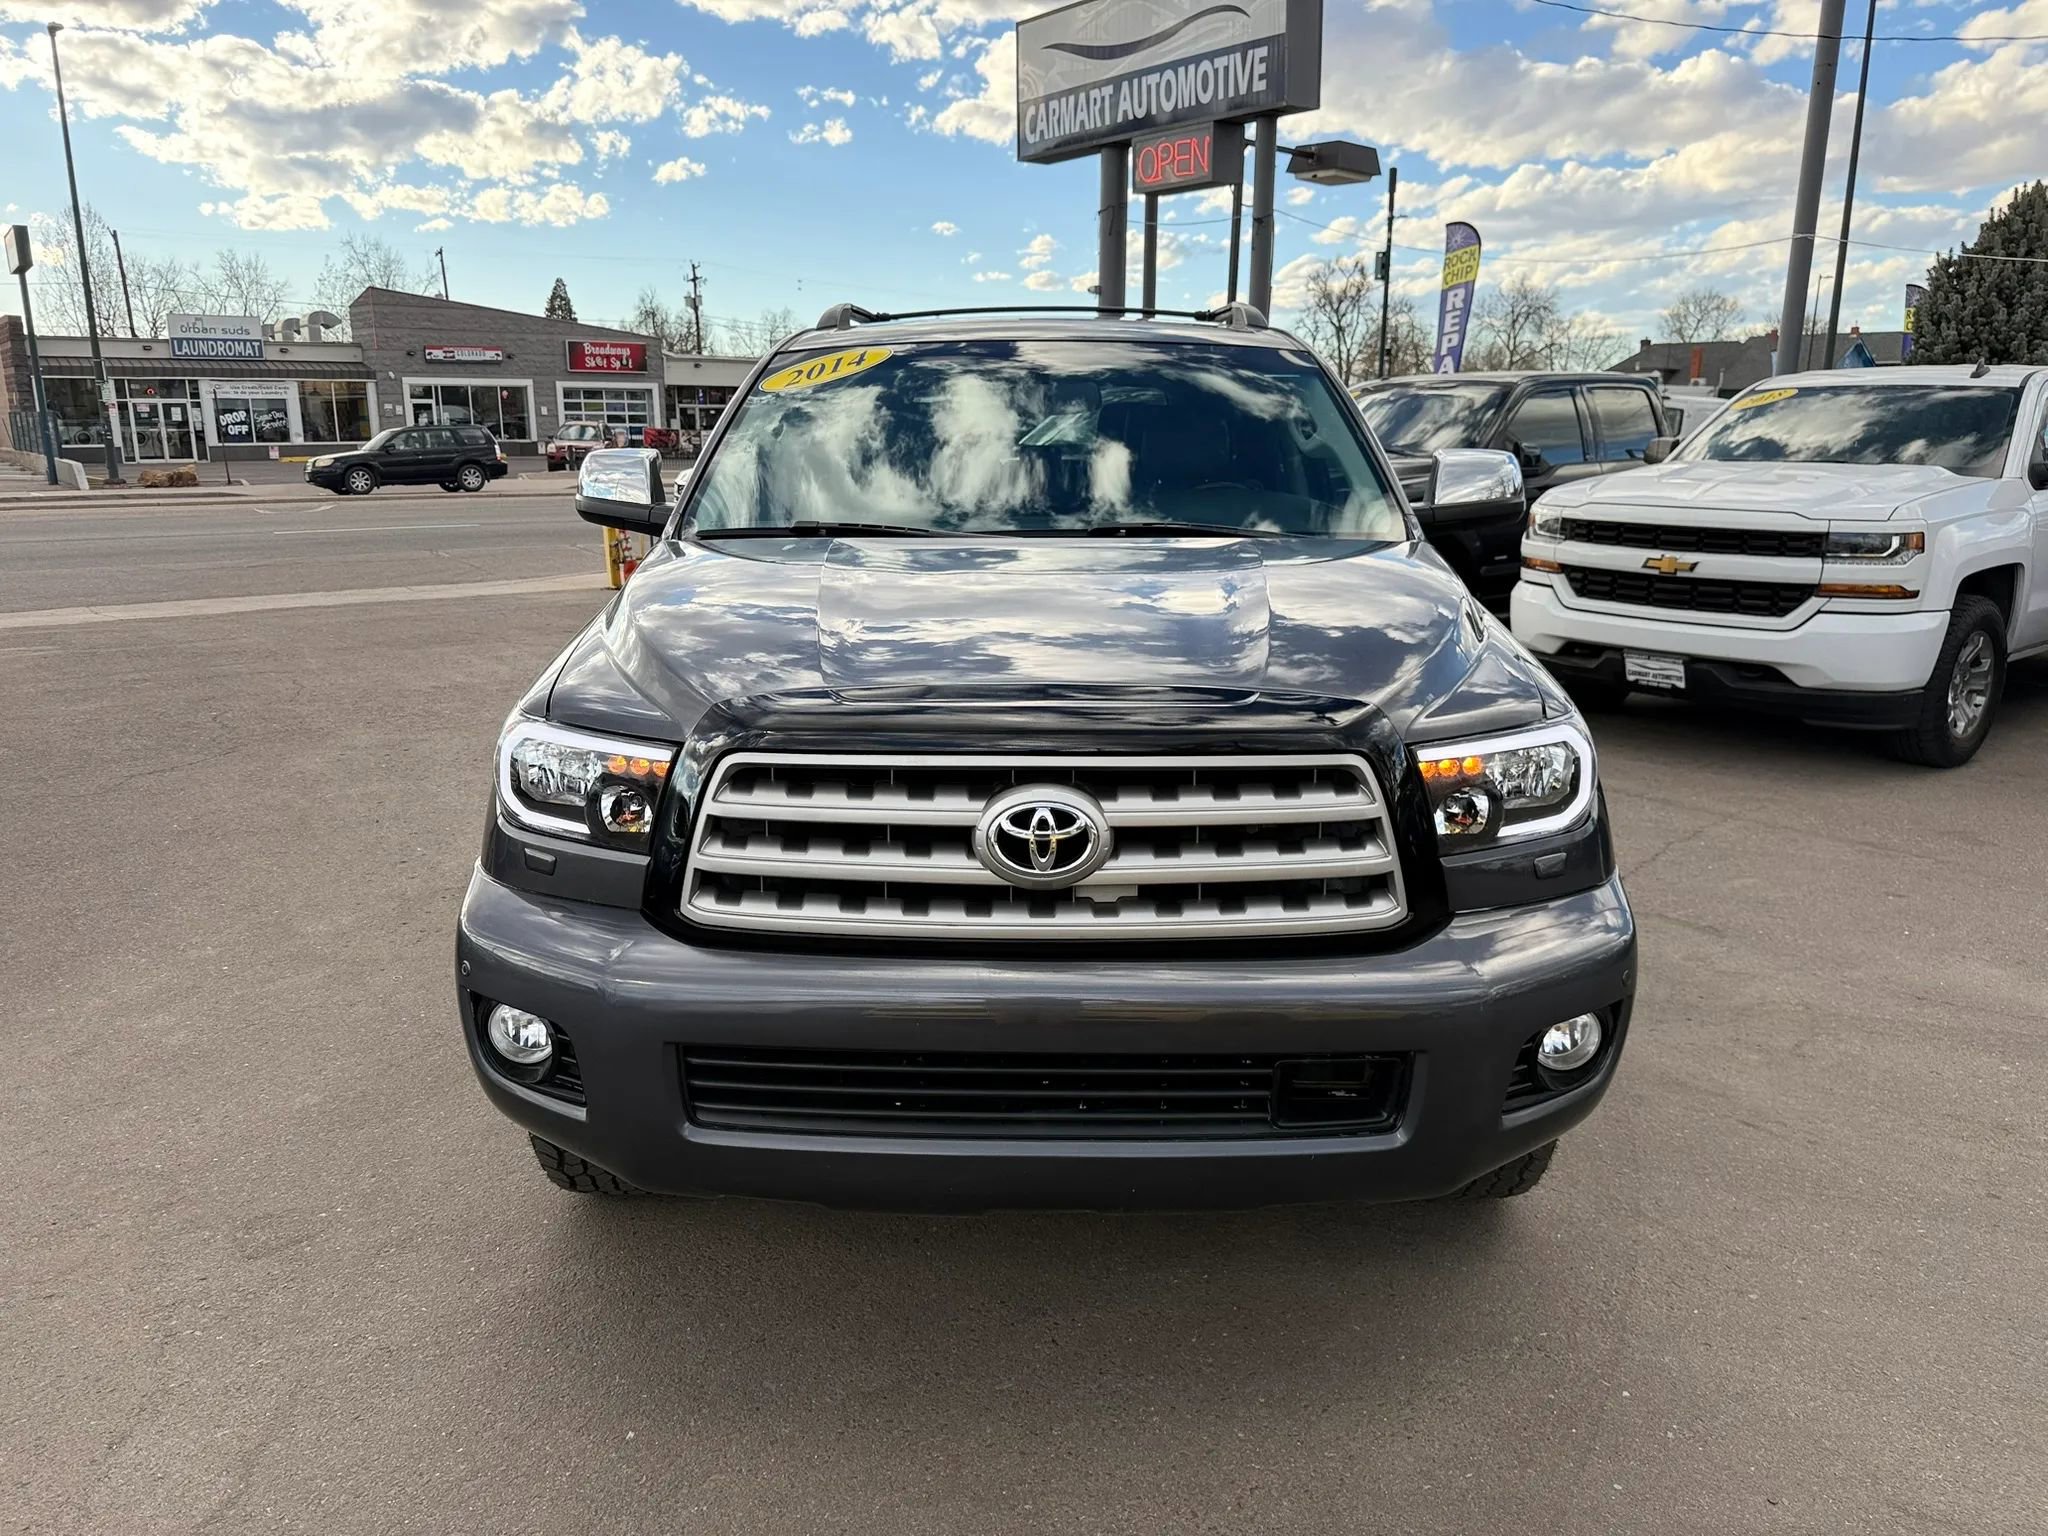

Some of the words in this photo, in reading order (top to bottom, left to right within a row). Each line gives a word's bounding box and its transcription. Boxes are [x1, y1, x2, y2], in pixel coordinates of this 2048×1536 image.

[1025, 84, 1113, 144] CARMART
[1117, 46, 1268, 123] AUTOMOTIVE
[1137, 135, 1210, 184] OPEN
[1443, 248, 1477, 272] ROCK
[1443, 265, 1474, 285] CHIP
[221, 326, 250, 336] suds
[173, 339, 260, 357] LAUNDROMAT
[784, 350, 868, 388] 2014
[219, 410, 247, 426] DROP
[227, 424, 249, 435] OFF
